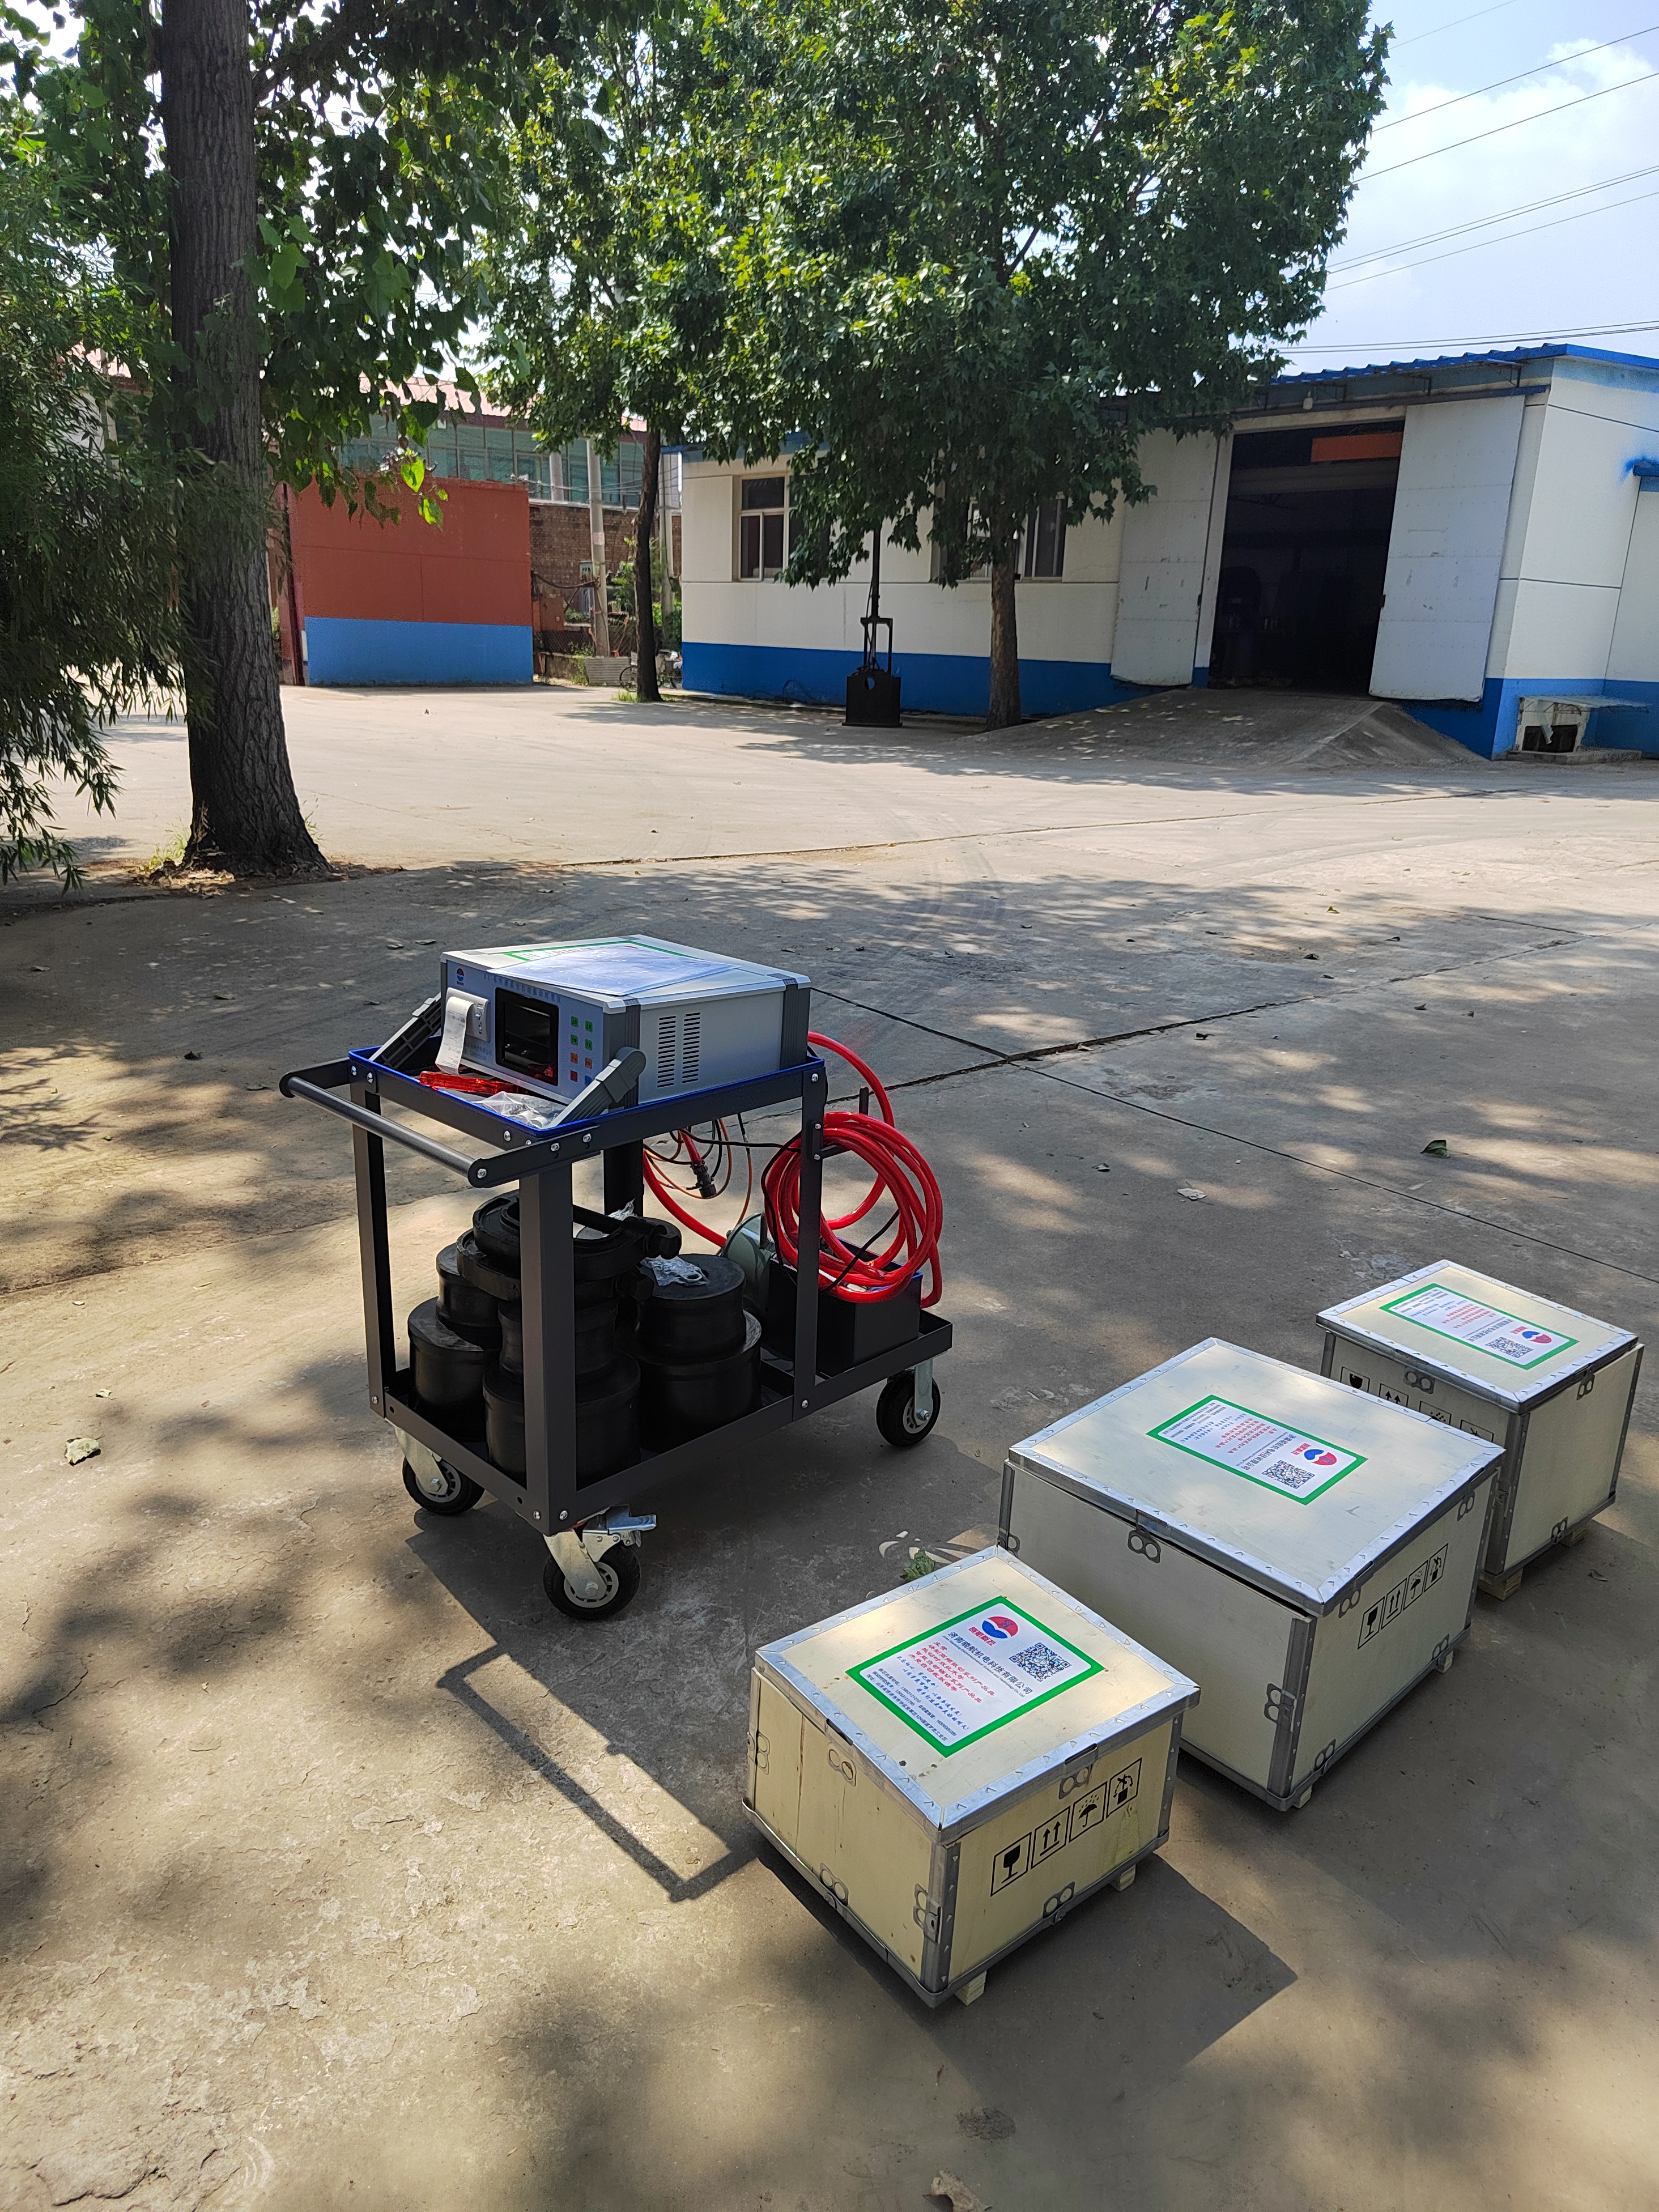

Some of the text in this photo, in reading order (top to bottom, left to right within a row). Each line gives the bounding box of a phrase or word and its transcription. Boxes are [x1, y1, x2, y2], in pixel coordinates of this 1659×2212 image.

[947, 1631, 1034, 1695] 济南晓航机电科技有限公司
